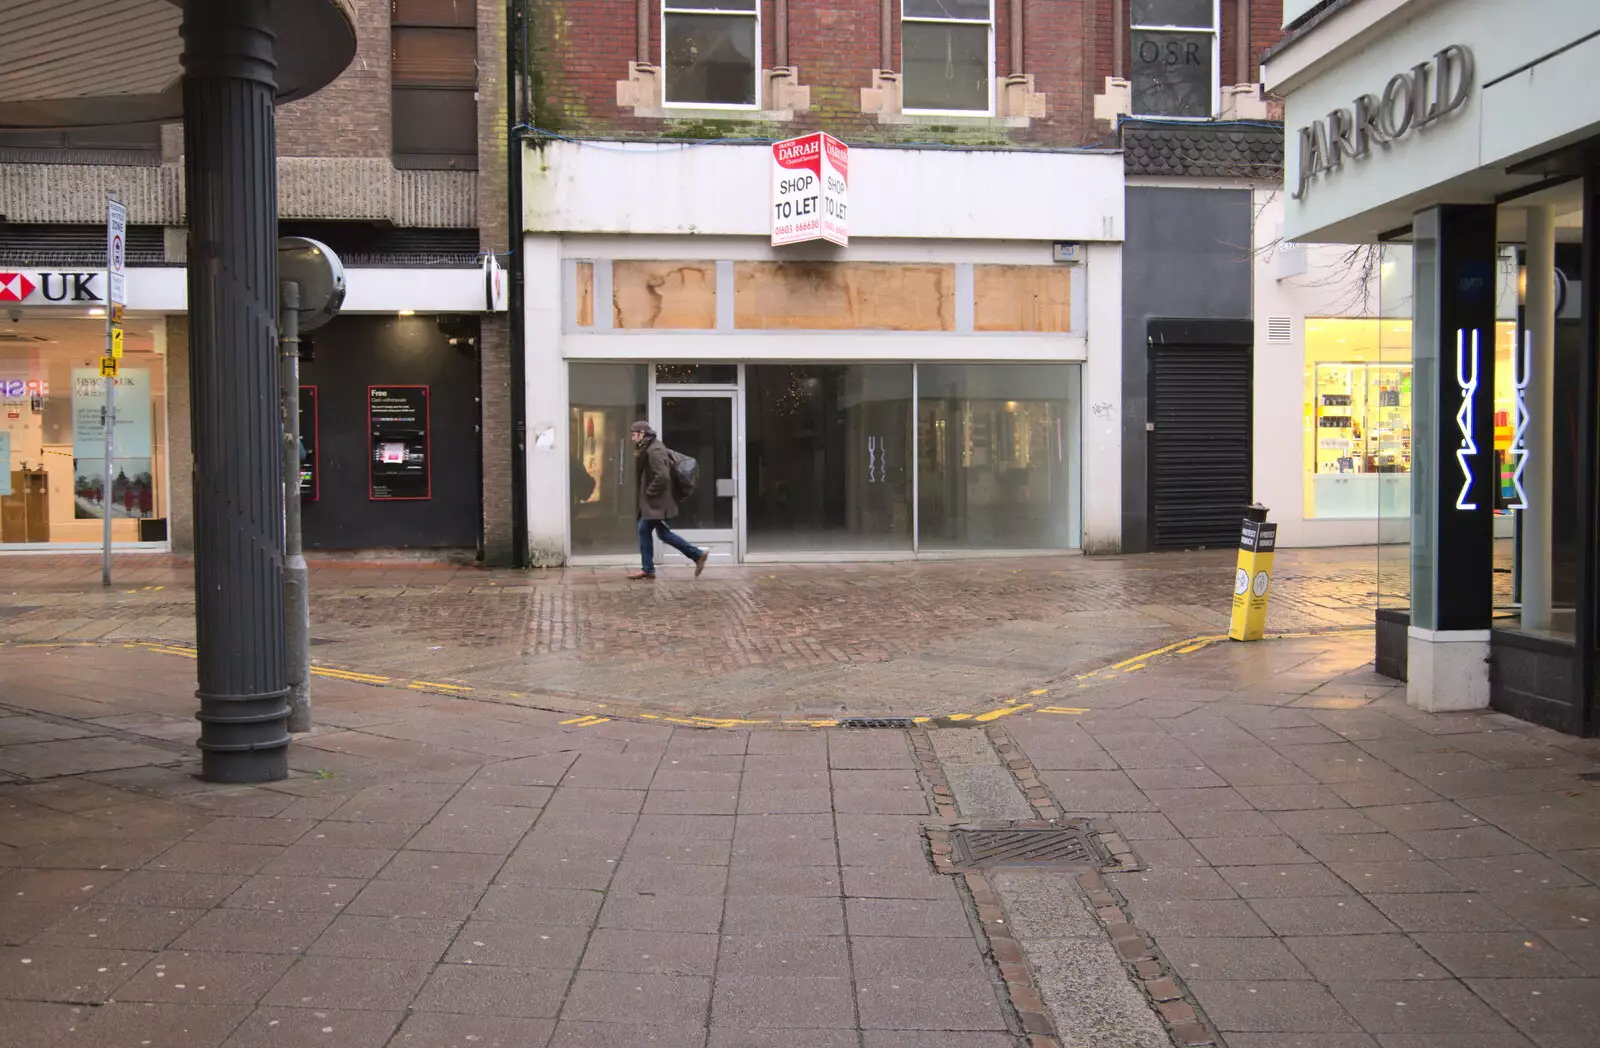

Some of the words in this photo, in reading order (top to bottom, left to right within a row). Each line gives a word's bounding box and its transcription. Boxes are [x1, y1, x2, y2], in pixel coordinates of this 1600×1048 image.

[1291, 43, 1475, 200] JARROLD
[778, 141, 819, 160] DARRAH
[780, 175, 813, 195] SHOP
[827, 176, 845, 195] SHOP
[775, 201, 792, 220] TO
[795, 196, 819, 216] LET
[825, 196, 835, 216] TO
[835, 201, 847, 221] LET
[775, 224, 793, 235] 01603
[38, 273, 103, 301] UK
[371, 389, 388, 397] Free
